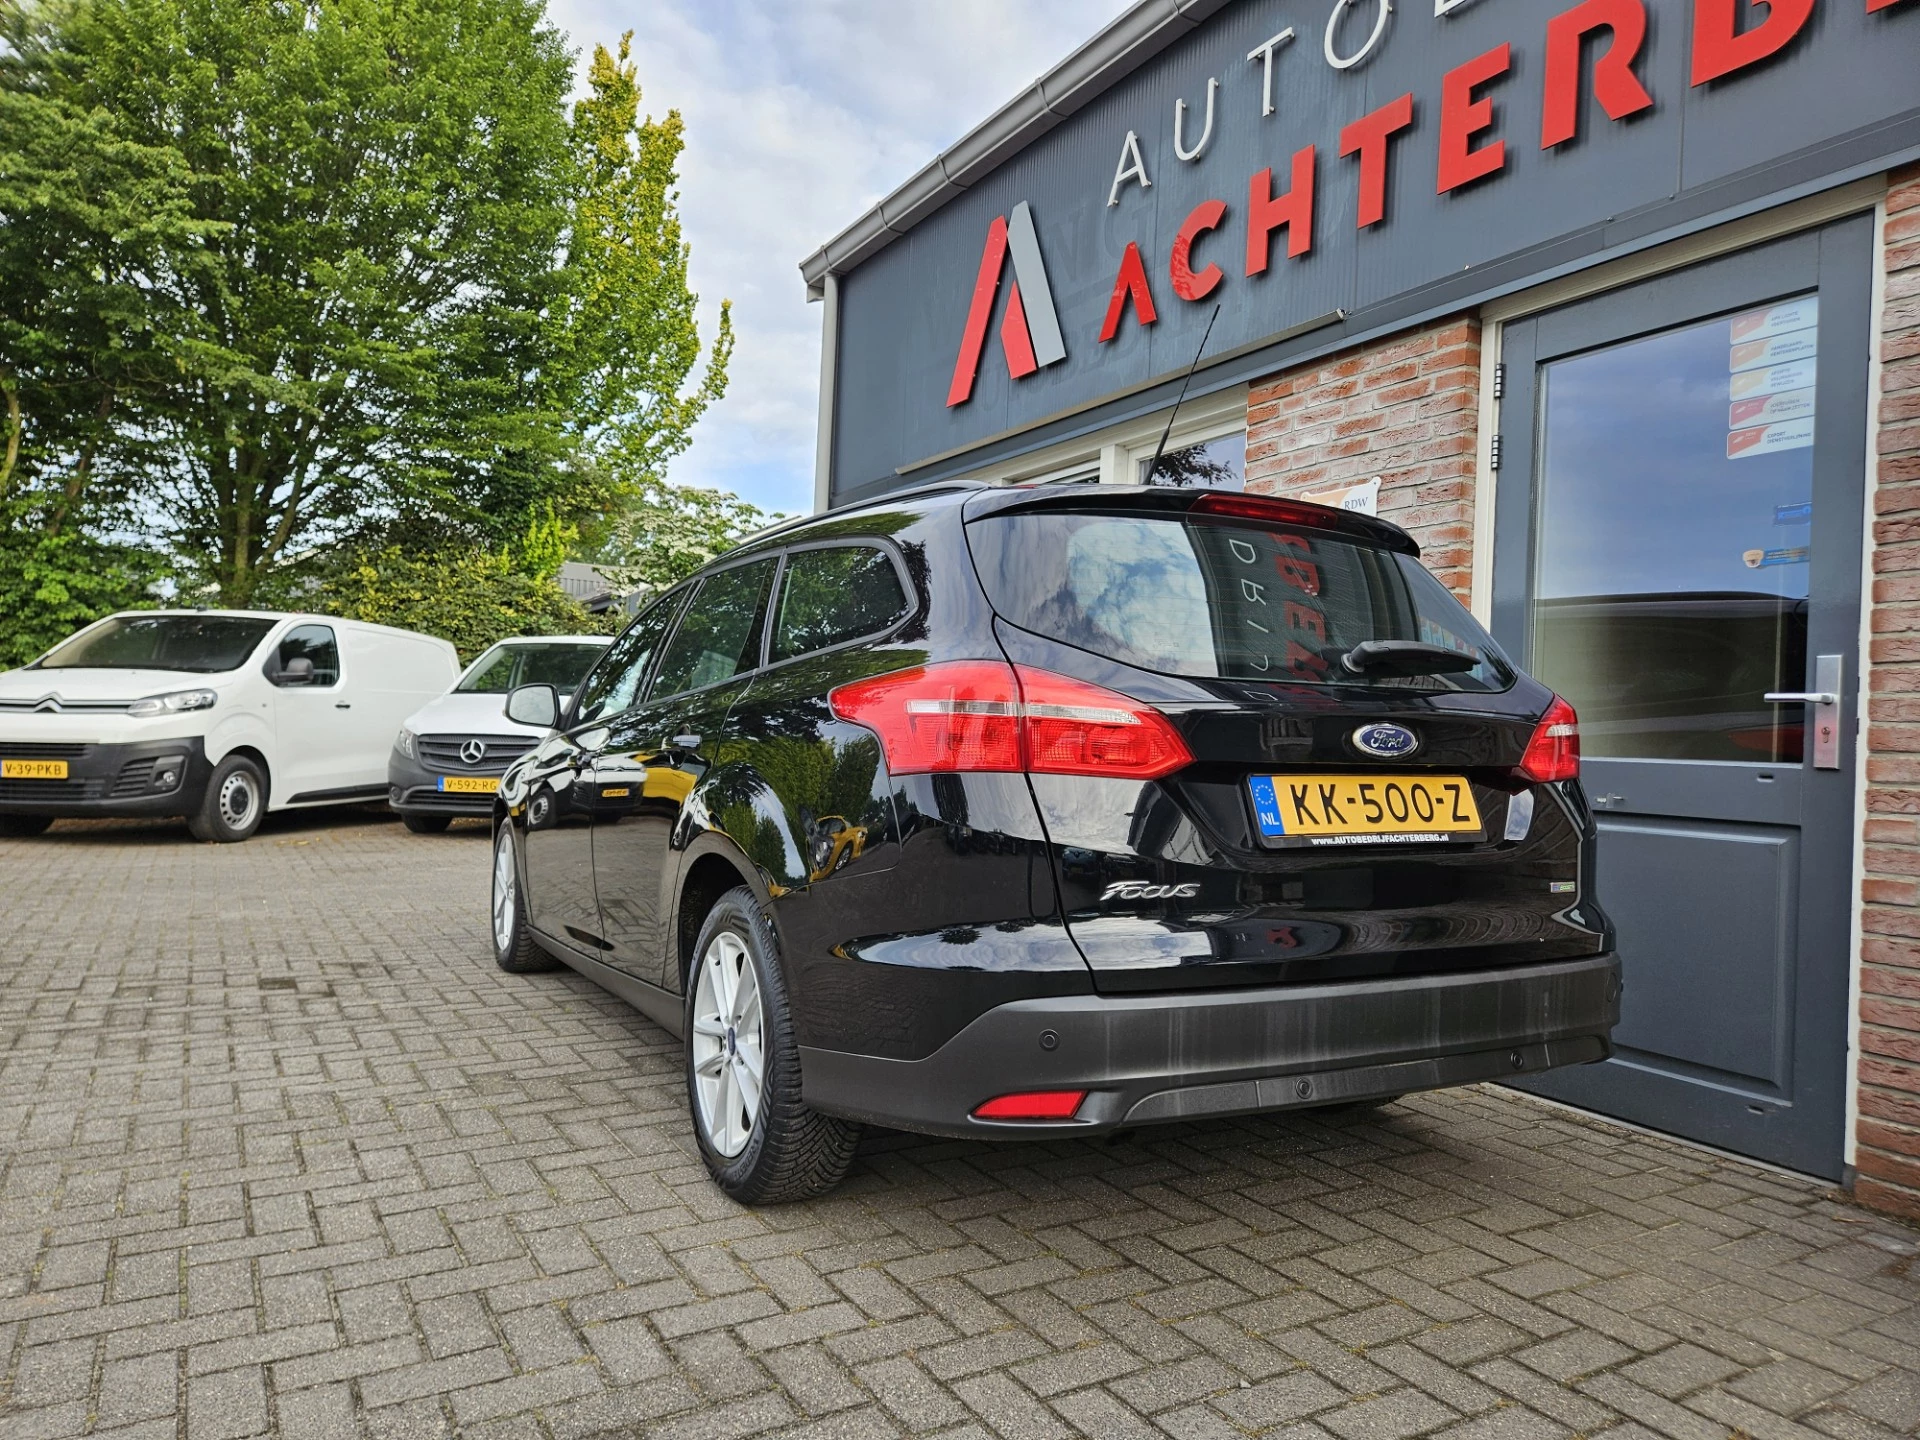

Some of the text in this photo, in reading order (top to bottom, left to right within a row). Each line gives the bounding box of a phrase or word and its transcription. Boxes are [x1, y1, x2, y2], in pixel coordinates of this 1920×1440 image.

[1107, 0, 1465, 206] AUTO
[1098, 0, 1899, 343] ACHTERB
[1344, 497, 1369, 511] RDW
[1370, 729, 1405, 748] Ford
[5, 763, 62, 776] V-39-PKB
[446, 779, 497, 791] V-592-RG
[1290, 782, 1471, 826] KK-500-Z
[1260, 812, 1280, 827] NL
